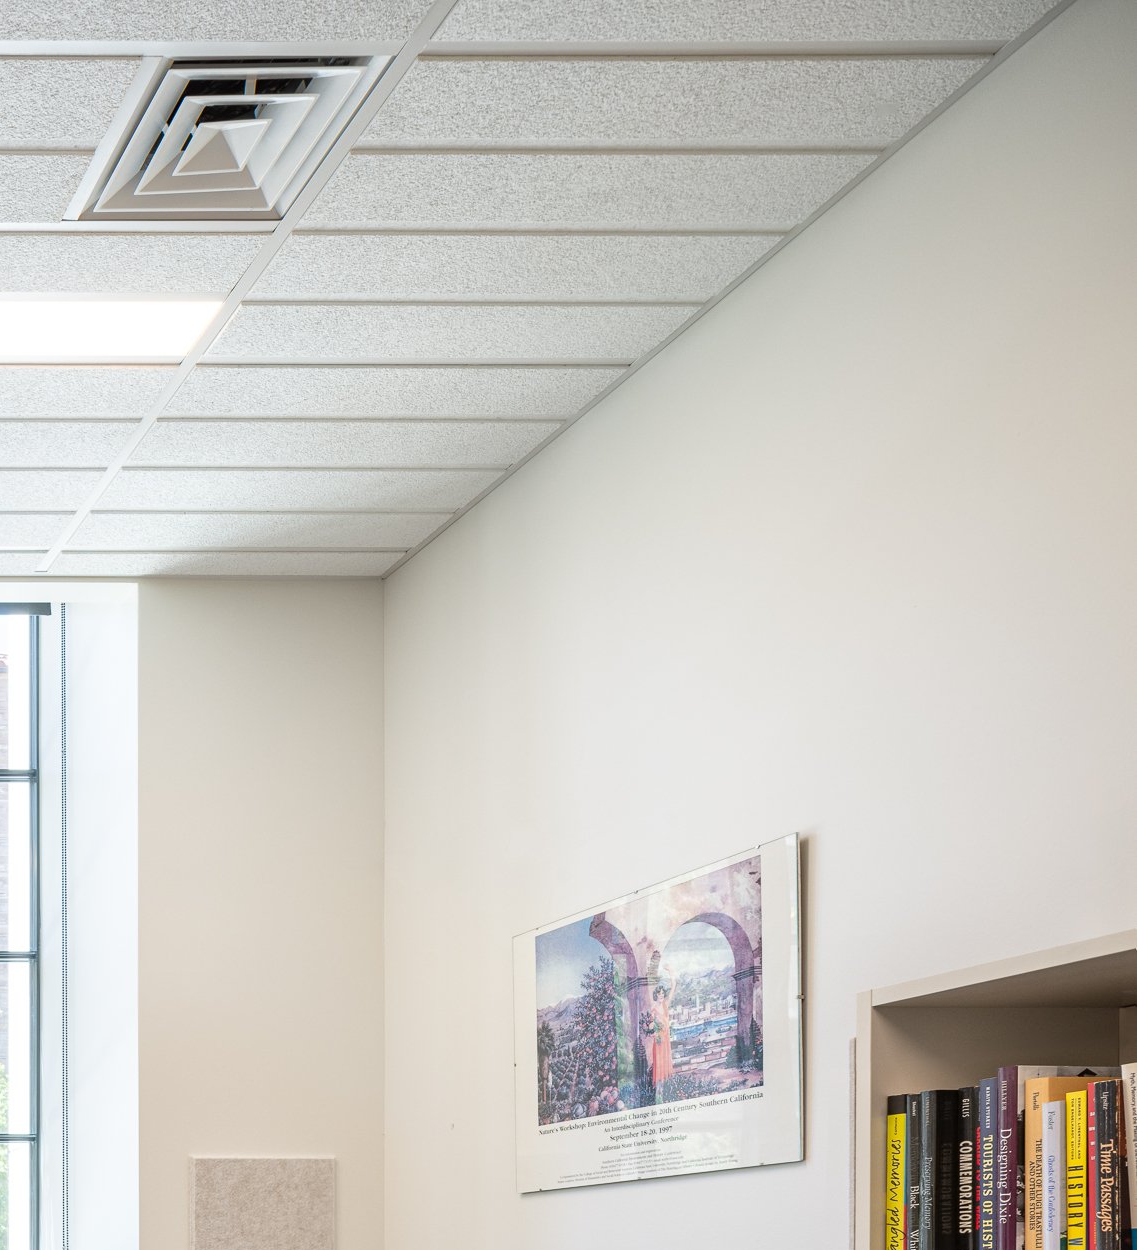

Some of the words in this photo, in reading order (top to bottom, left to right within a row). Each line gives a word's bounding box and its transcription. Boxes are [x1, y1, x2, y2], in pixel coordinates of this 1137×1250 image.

[559, 1122, 586, 1132] Workshop:
[587, 1115, 628, 1128] Environmental
[629, 1111, 650, 1122] Change
[659, 1106, 672, 1115] 20th
[673, 1103, 698, 1114] Century
[699, 1098, 728, 1109] Southern
[729, 1091, 764, 1104] California
[611, 1121, 651, 1131] Interdisciplinary
[651, 1116, 679, 1125] Conference
[961, 1098, 970, 1118] GILLIS
[598, 1143, 621, 1152] California
[660, 1134, 688, 1143] Northridge
[609, 1131, 639, 1141] September
[659, 1125, 673, 1134] 1997
[886, 1139, 900, 1203] Memories
[982, 1134, 994, 1197] TOURISTS
[997, 1128, 1012, 1189] Designing
[1100, 1139, 1116, 1174] Time
[909, 1185, 920, 1209] Black
[958, 1140, 973, 1234] COMMEMORATIONS
[1068, 1165, 1084, 1228] HISTORY
[1096, 1176, 1115, 1232] Passages
[982, 1200, 994, 1215] OF
[999, 1192, 1012, 1224] Dixie
